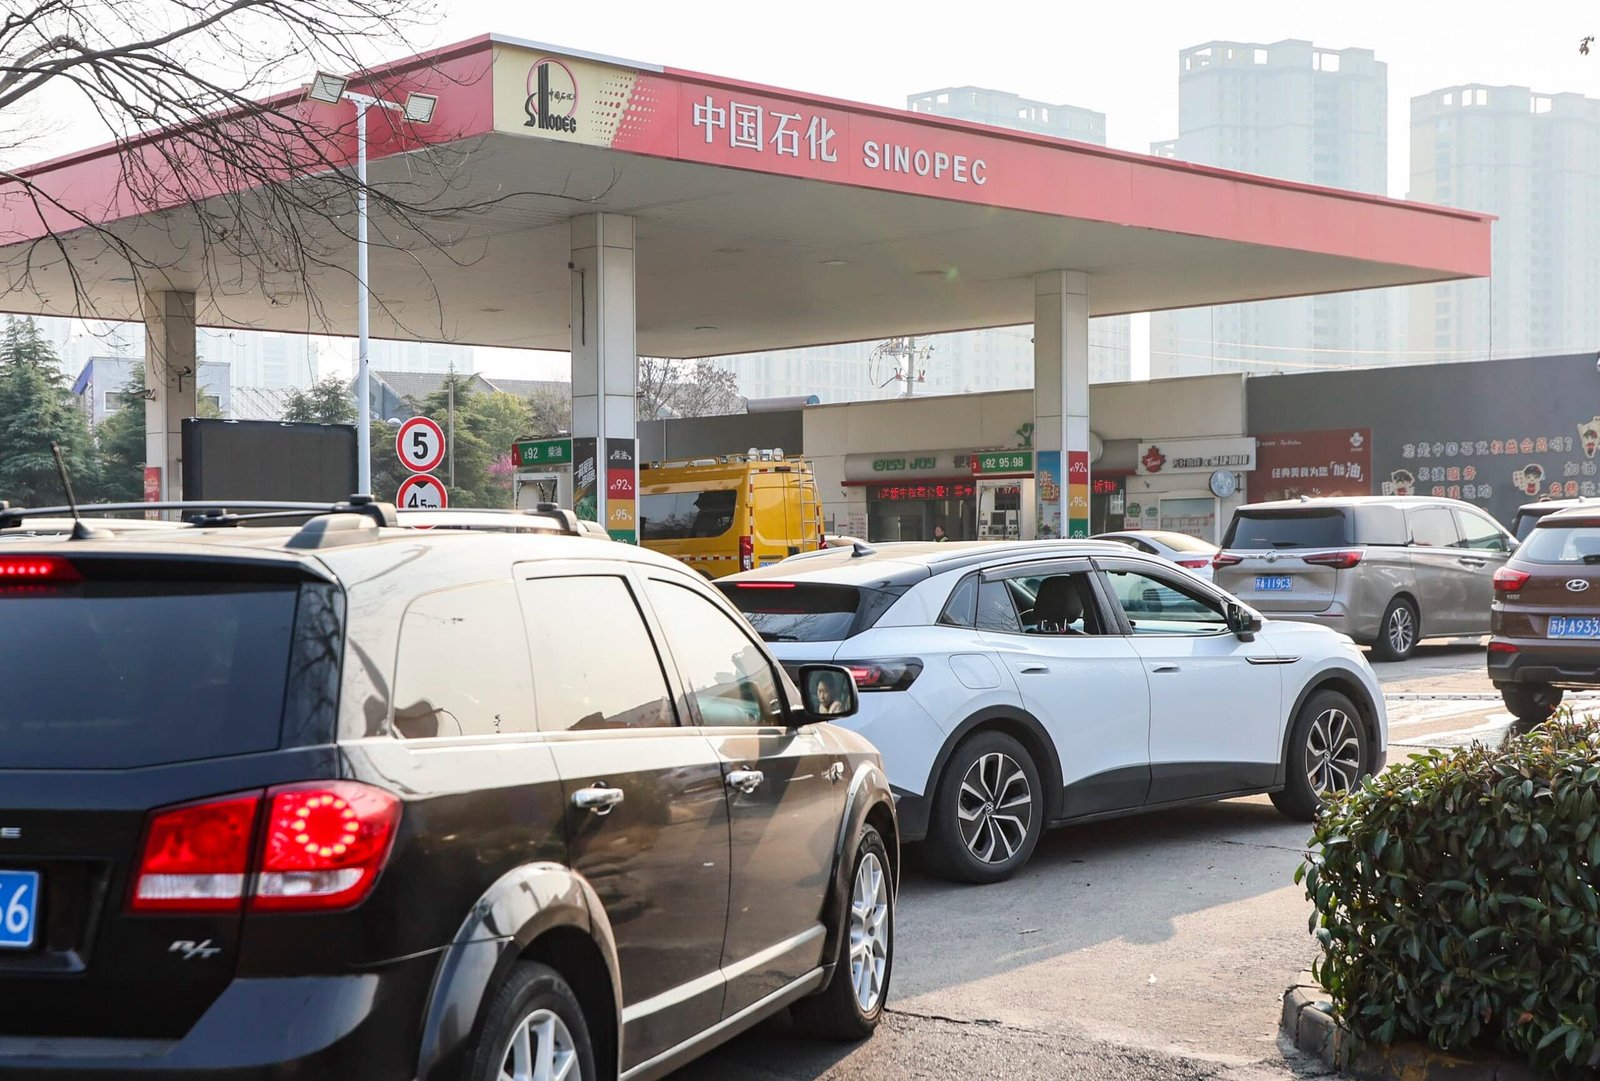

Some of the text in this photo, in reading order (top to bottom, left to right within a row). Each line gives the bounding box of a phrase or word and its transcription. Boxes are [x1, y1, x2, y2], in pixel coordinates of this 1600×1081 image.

[692, 95, 988, 185] 中国石化 SINOPEC
[413, 431, 429, 460] 5
[547, 445, 563, 458] 柴油
[909, 455, 937, 471] JOY
[999, 457, 1010, 468] 95
[1012, 456, 1024, 468] 98
[0, 883, 29, 934] 6
